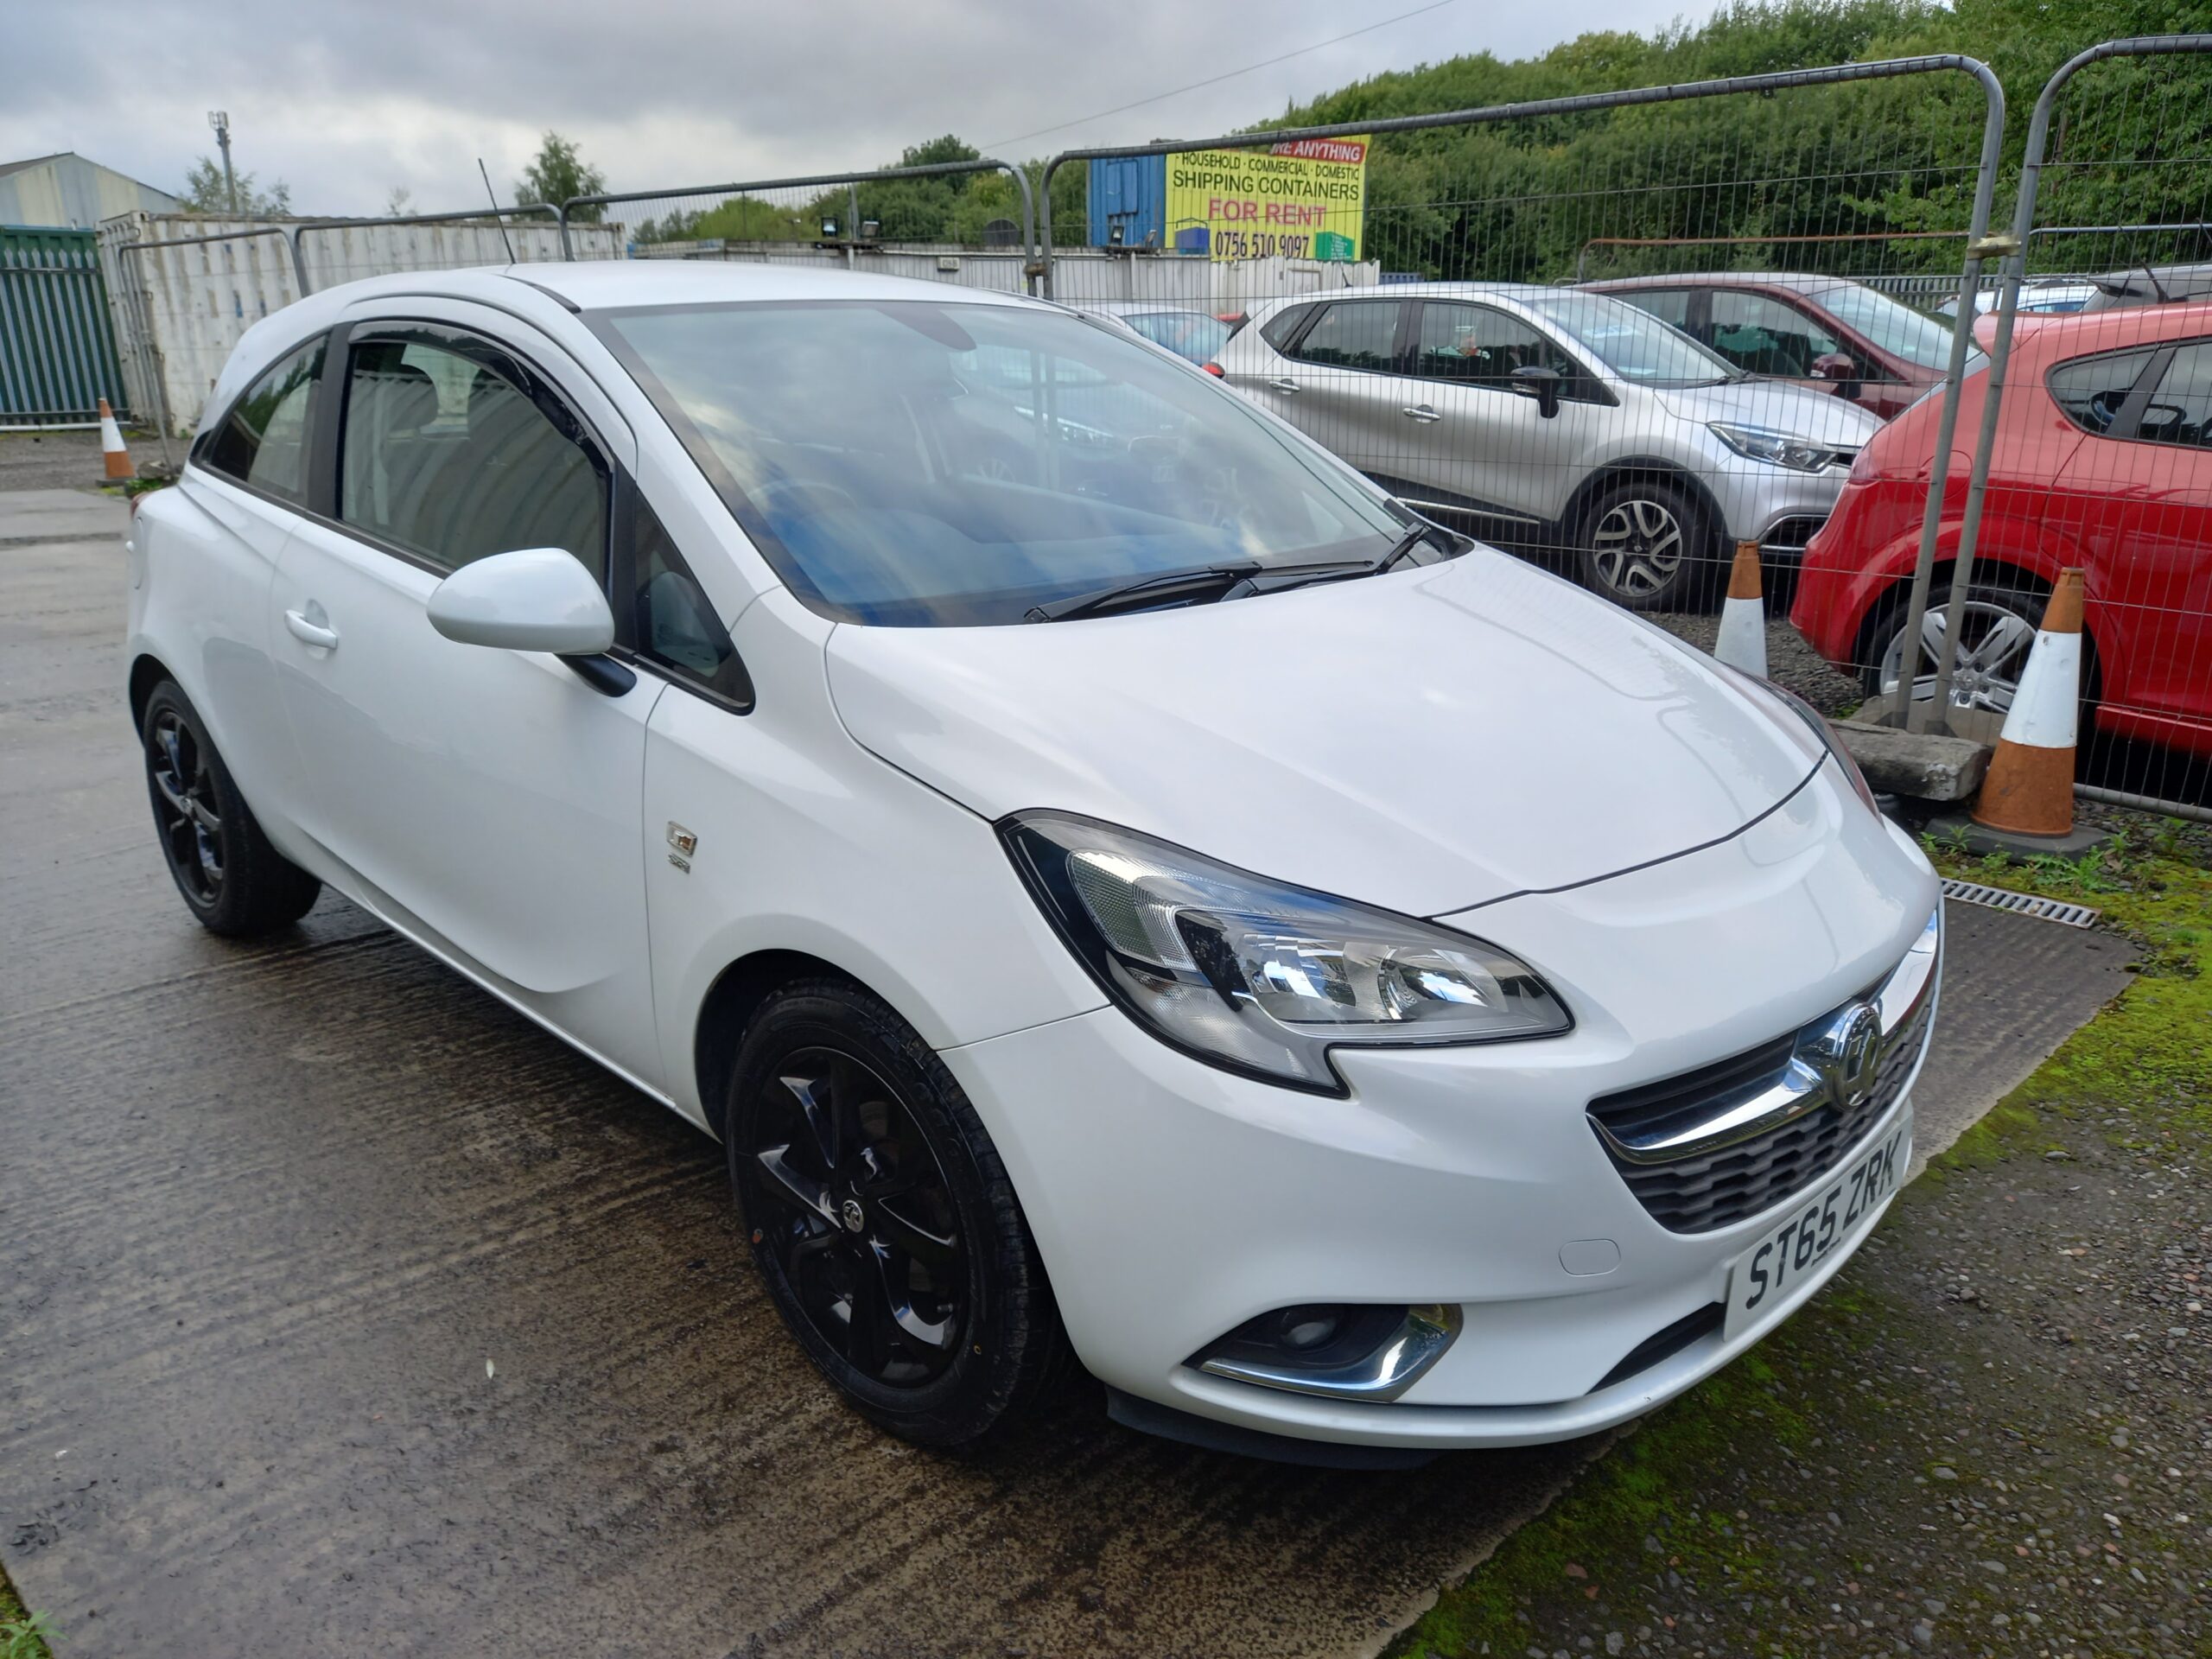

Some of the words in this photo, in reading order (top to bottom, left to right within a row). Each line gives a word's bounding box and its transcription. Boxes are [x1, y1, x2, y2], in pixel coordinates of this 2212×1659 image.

[1294, 140, 1360, 162] ANYTHING
[1181, 152, 1241, 170] HOUSEHOLD
[1249, 158, 1308, 175] COMMERCIAL
[1315, 165, 1359, 181] DOMESTIC
[1173, 171, 1254, 193] SHIPPING
[1258, 177, 1359, 200] CONTAINERS
[1209, 199, 1258, 221] FOR
[1266, 204, 1326, 226] RENT
[1216, 231, 1248, 257] 0756
[1745, 1186, 1841, 1310] ST65
[1842, 1131, 1902, 1230] ZRK
